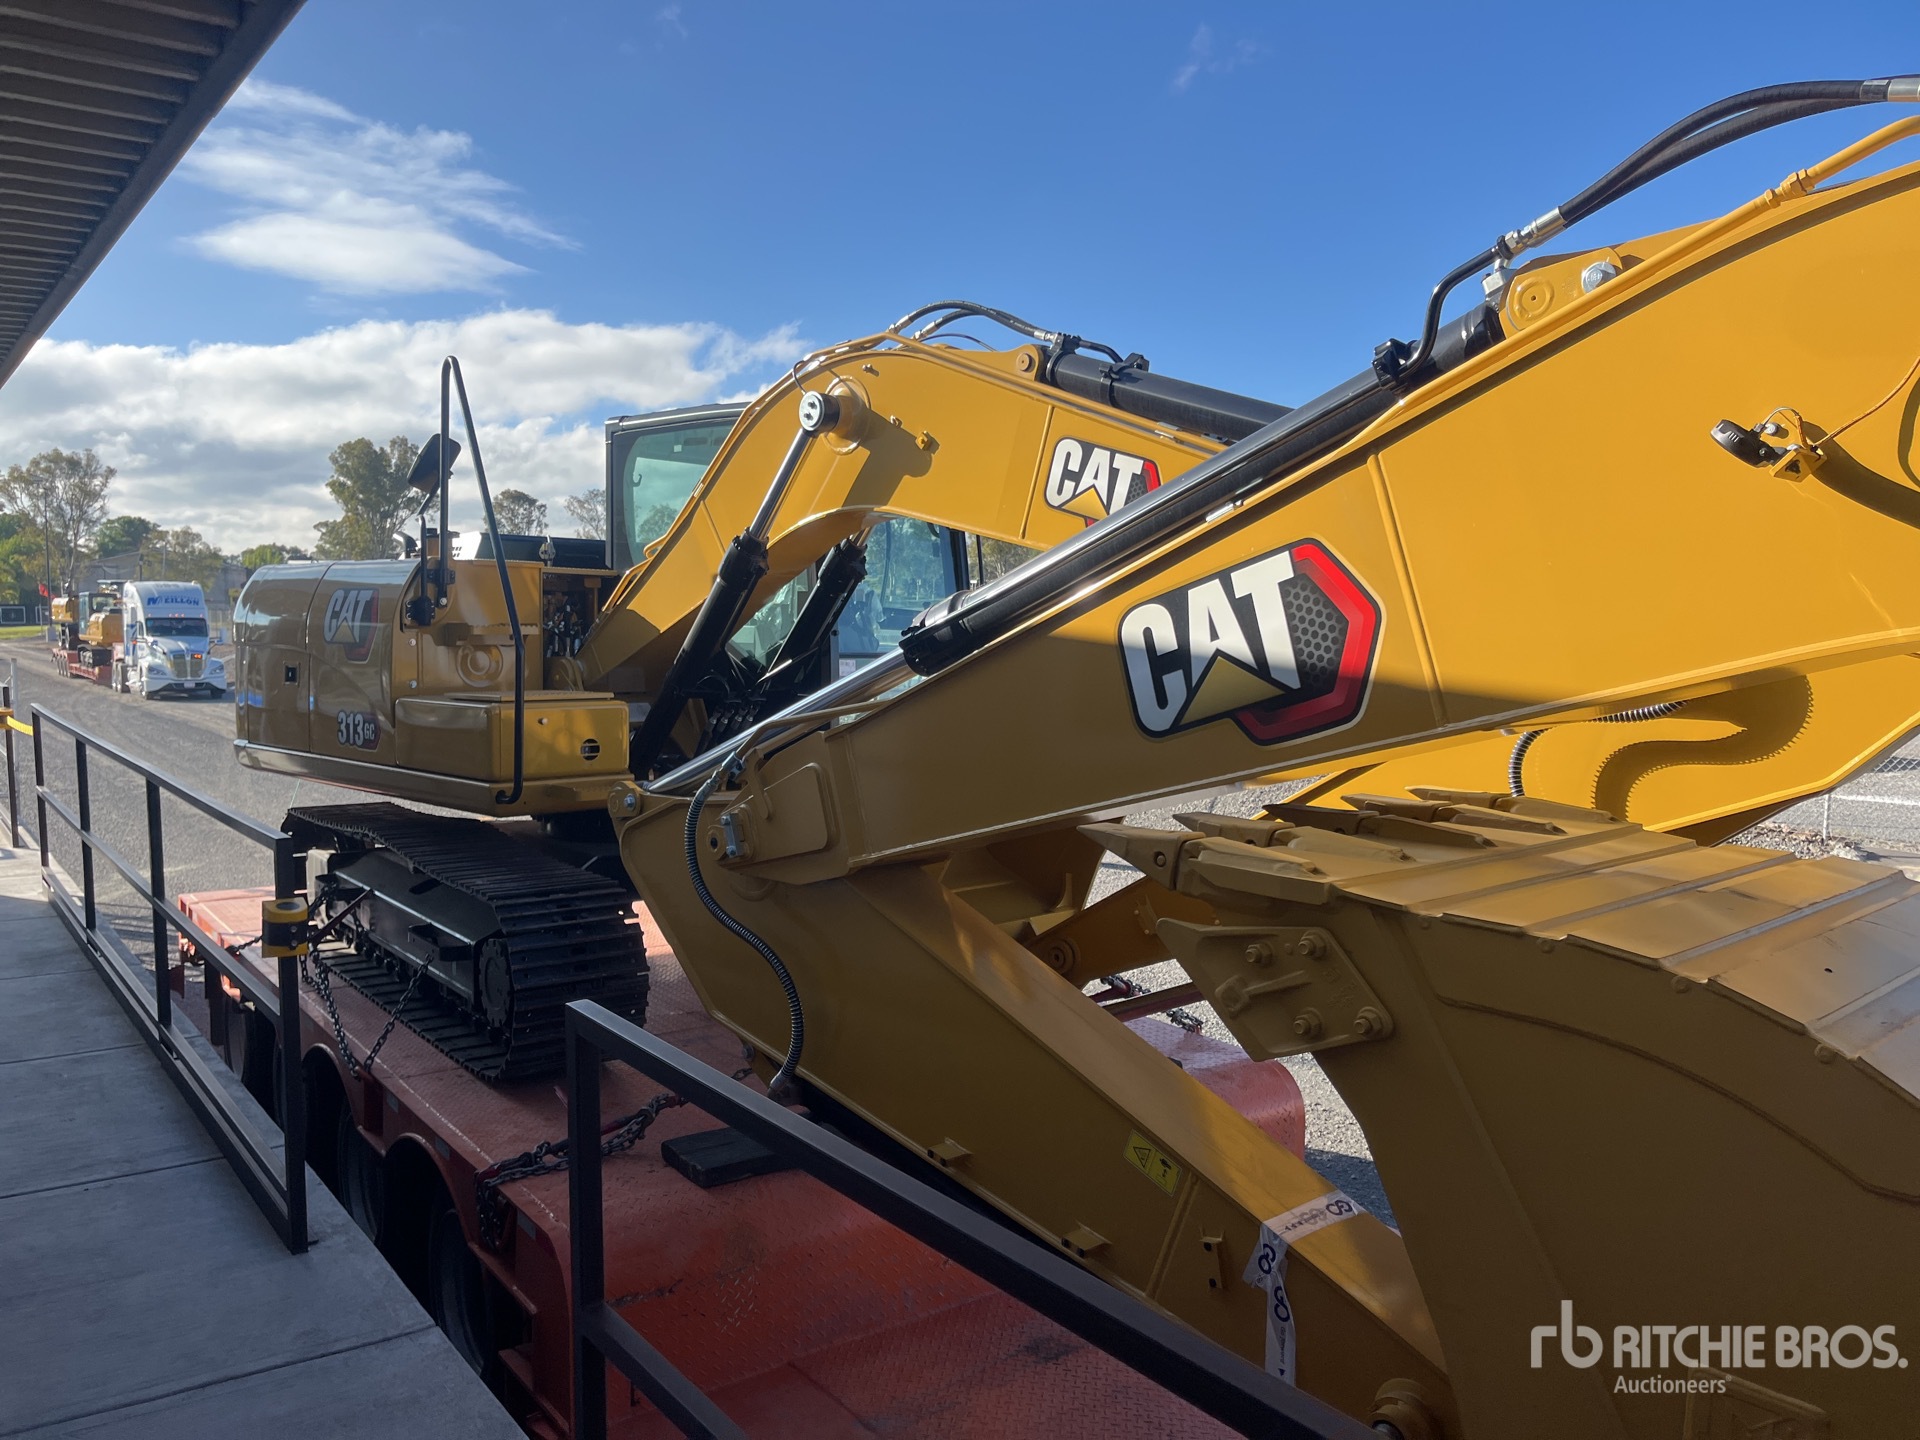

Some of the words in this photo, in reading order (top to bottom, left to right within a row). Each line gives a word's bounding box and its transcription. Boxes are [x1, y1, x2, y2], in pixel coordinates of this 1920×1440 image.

[1045, 438, 1144, 515] CAT
[323, 588, 374, 644] CAT
[1121, 550, 1301, 732] CAT
[337, 711, 364, 746] 313
[364, 722, 376, 740] GC
